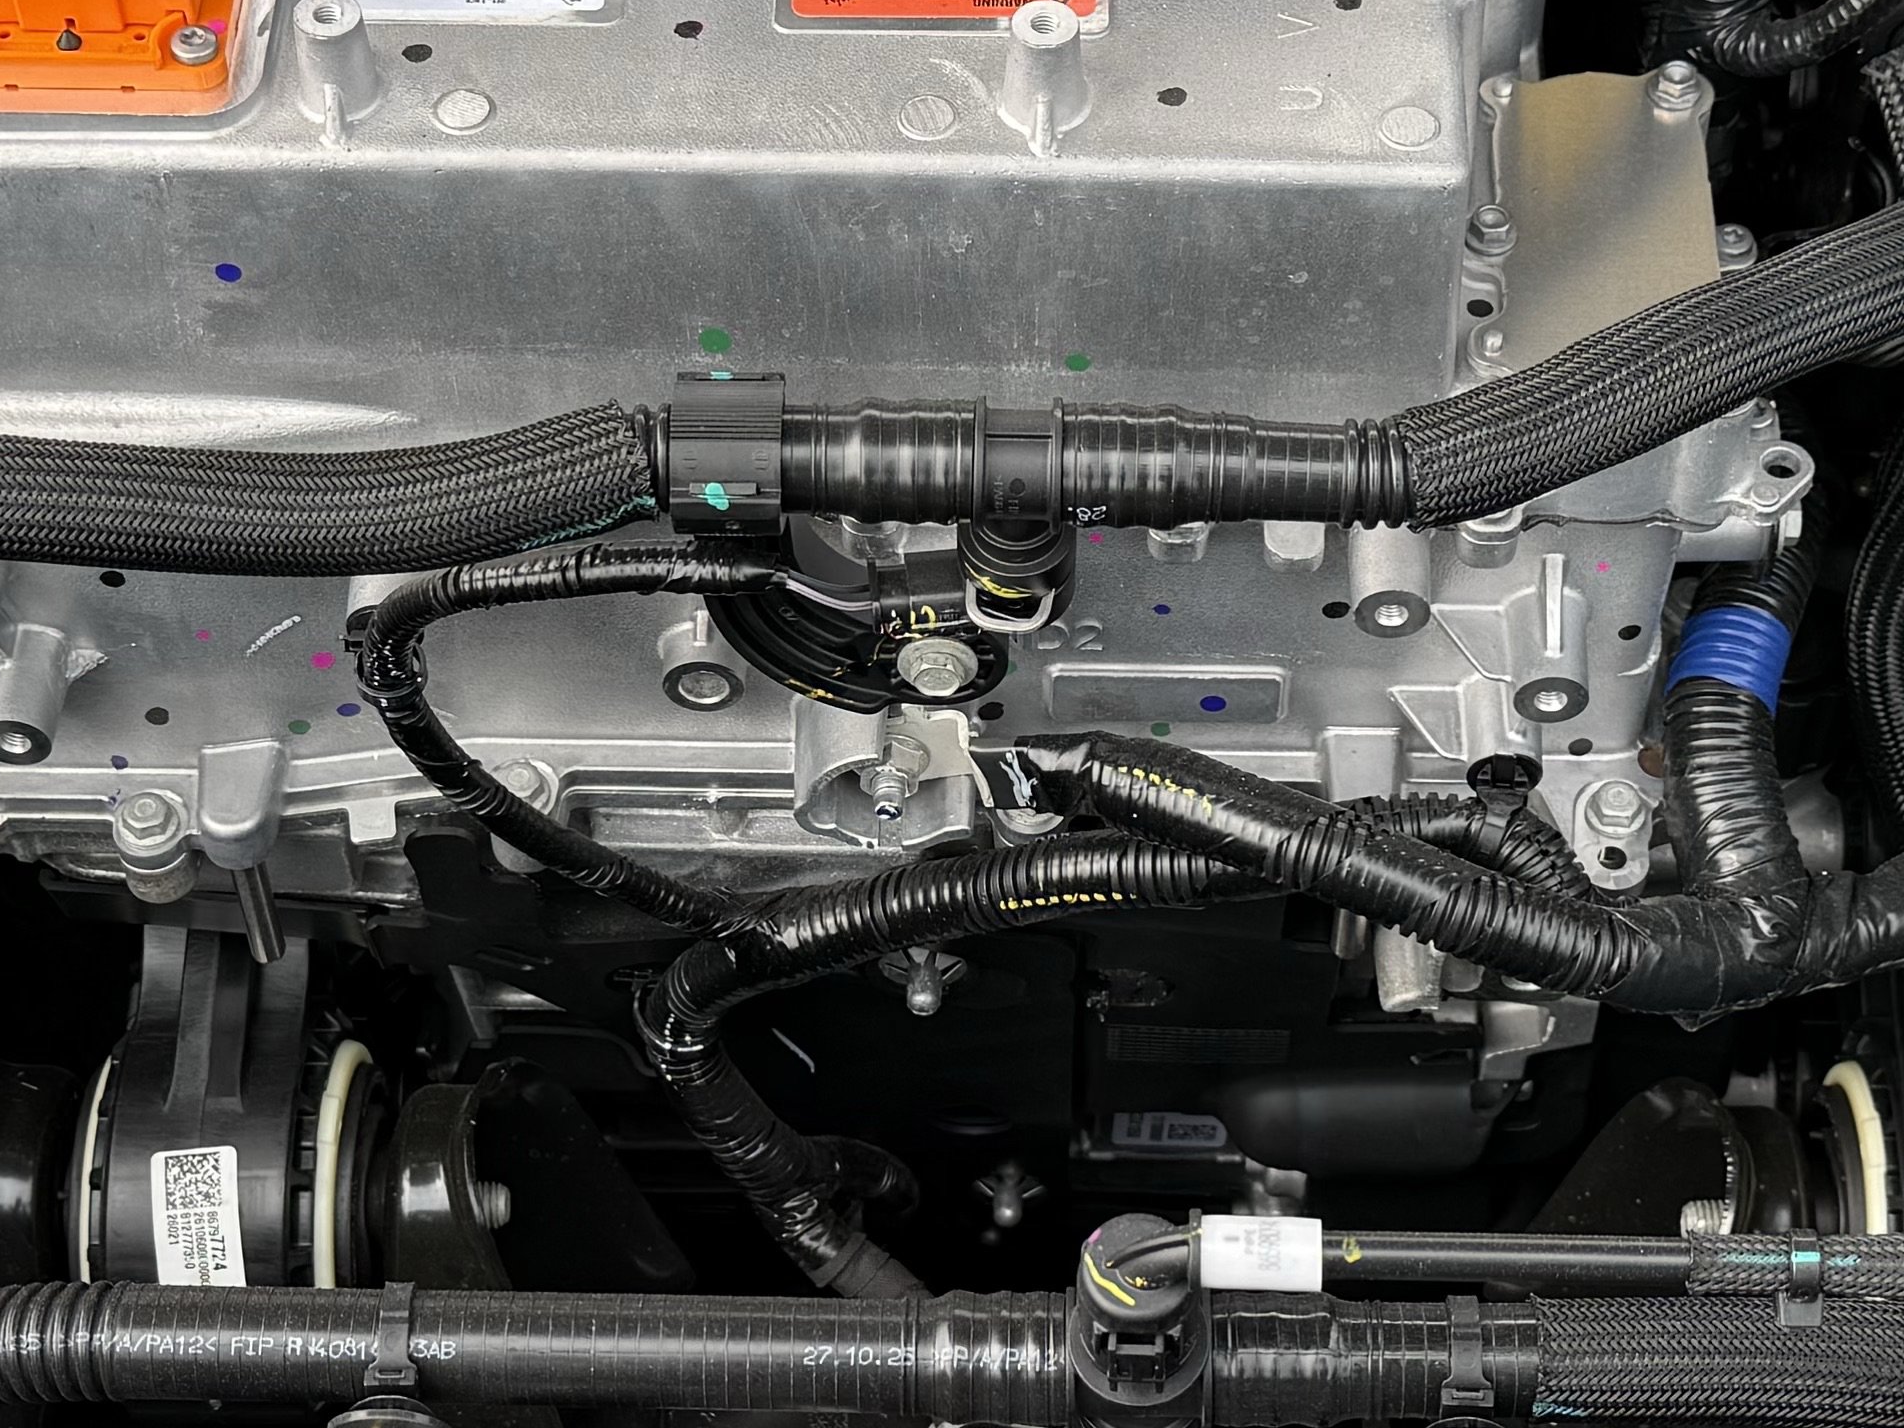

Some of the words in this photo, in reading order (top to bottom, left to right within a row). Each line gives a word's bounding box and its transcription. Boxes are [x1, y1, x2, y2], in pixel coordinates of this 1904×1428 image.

[165, 1213, 180, 1246] 26021
[206, 1209, 228, 1271] 86797724
[229, 1335, 274, 1356] FIP
